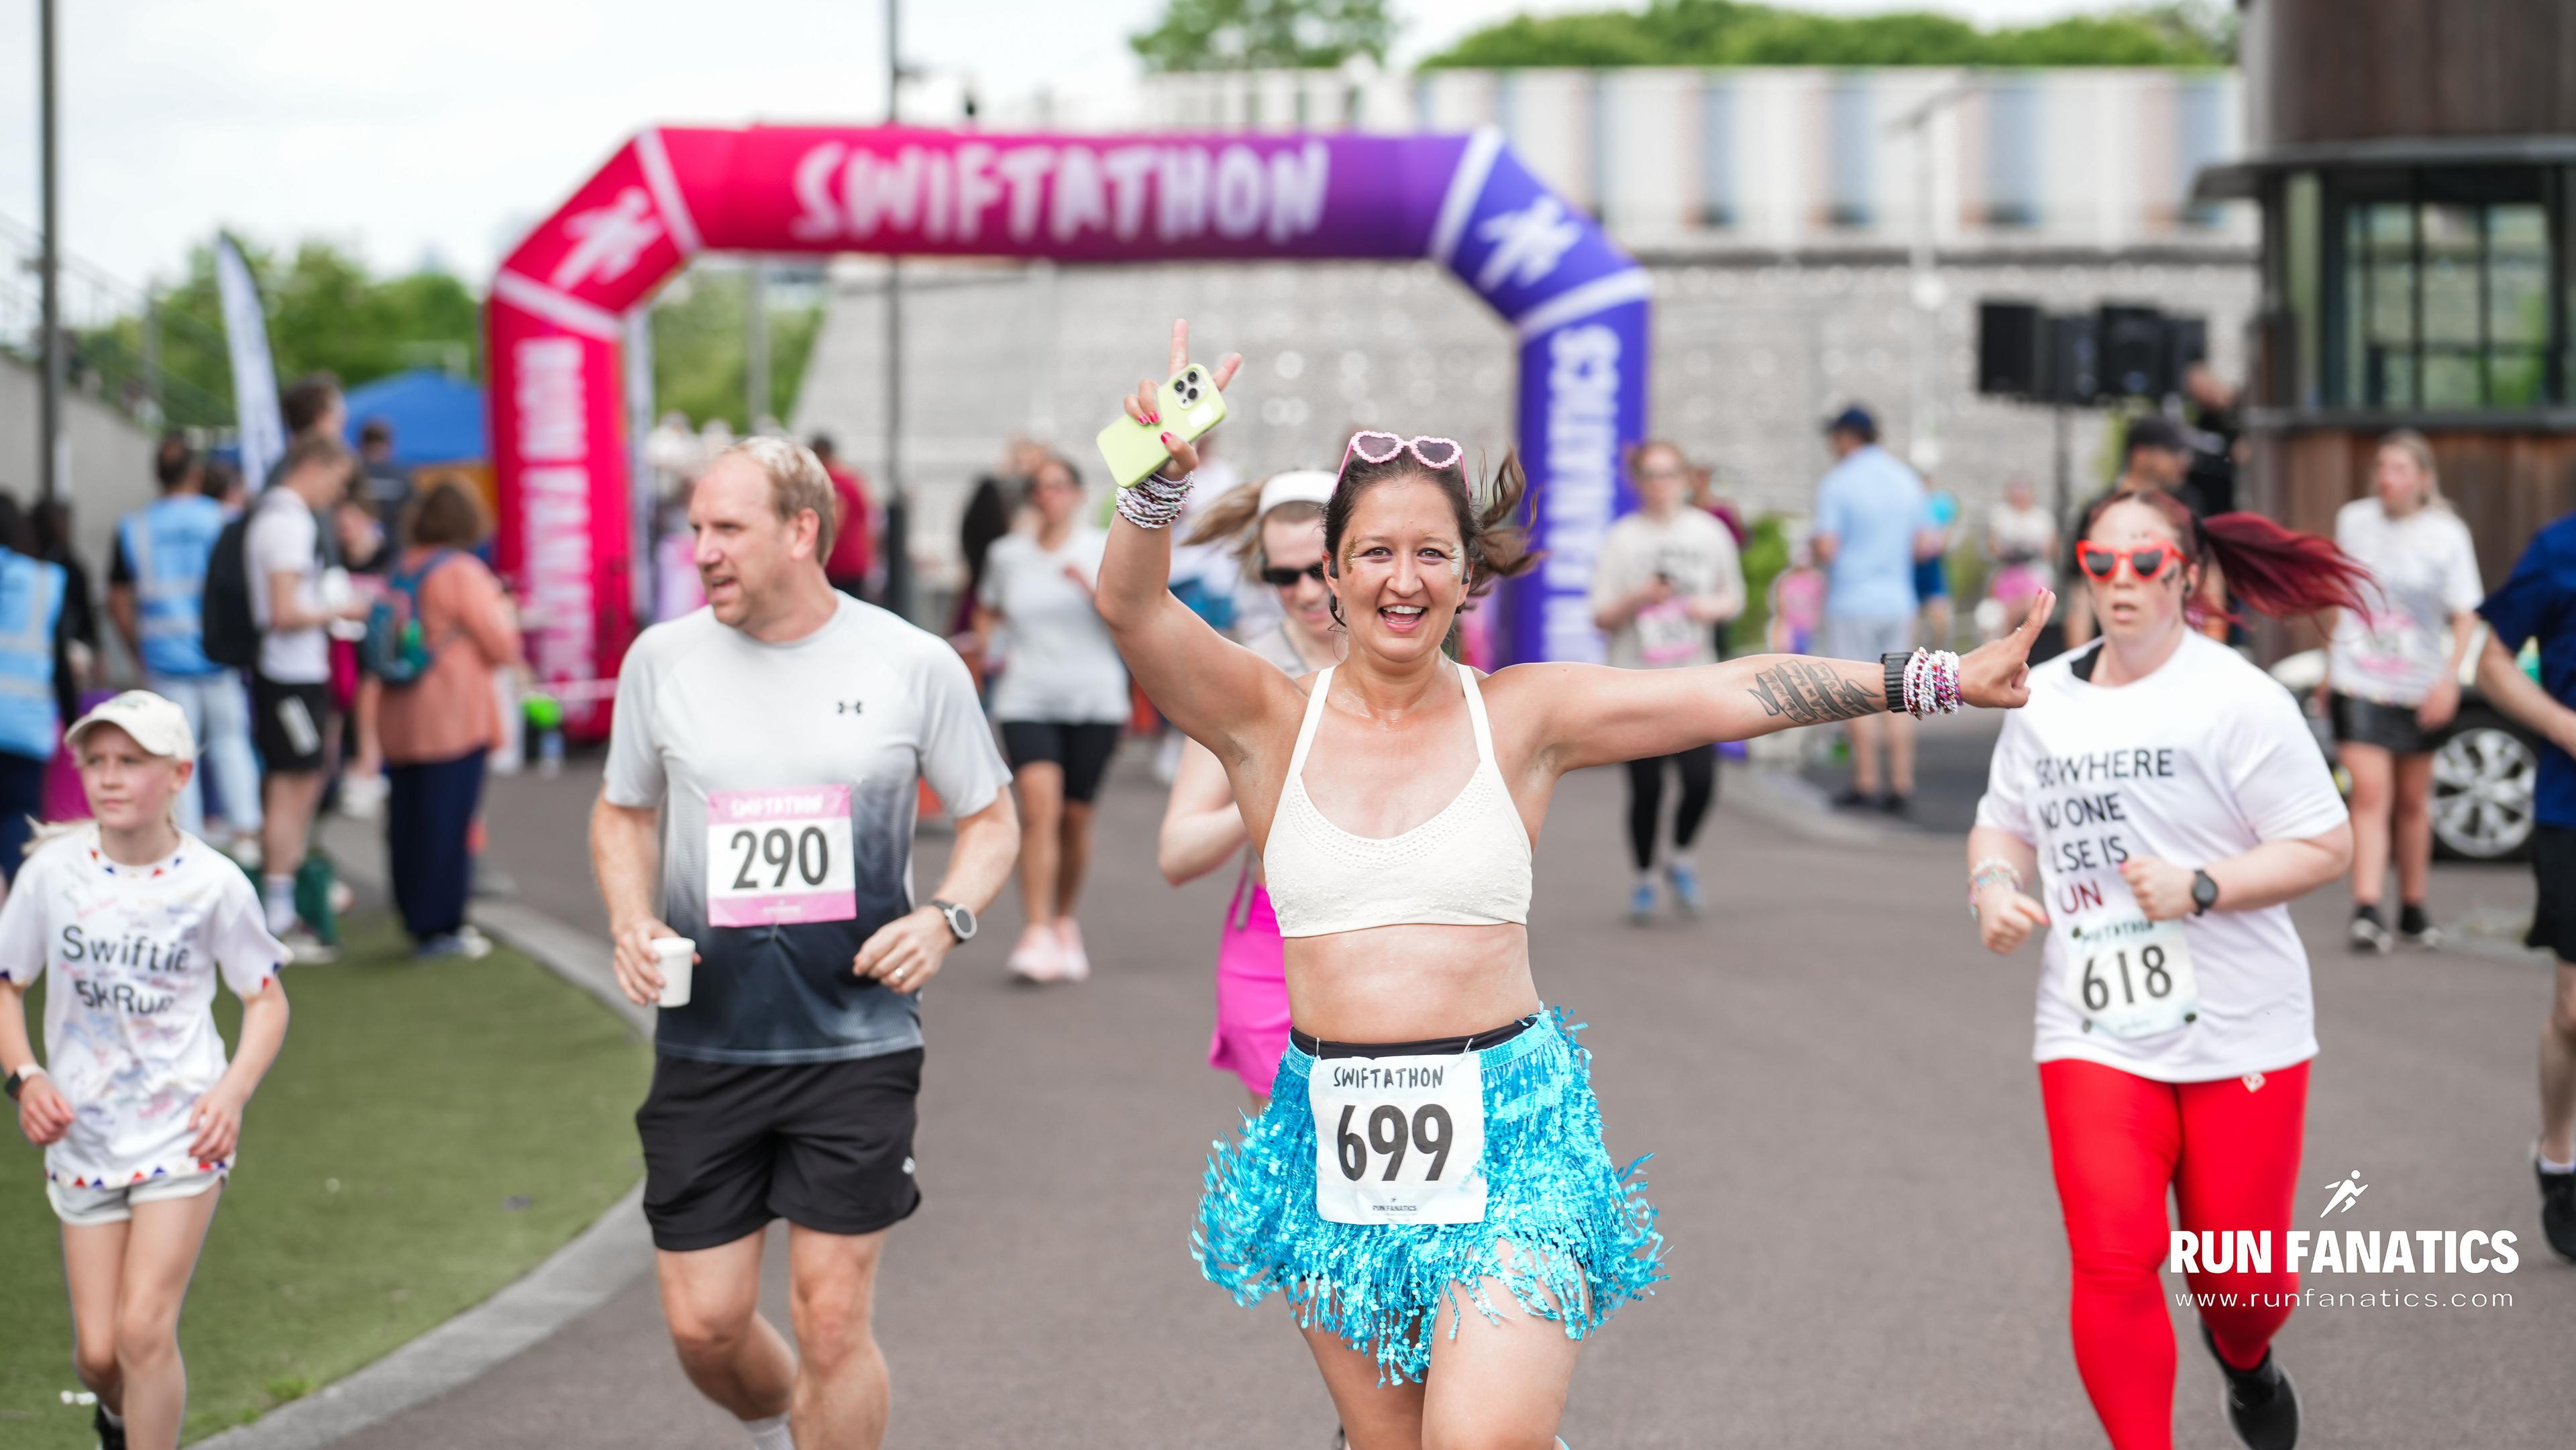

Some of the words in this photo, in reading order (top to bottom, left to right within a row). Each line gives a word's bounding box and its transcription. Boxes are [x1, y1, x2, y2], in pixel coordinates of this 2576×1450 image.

[788, 139, 1332, 243] SWIFTATHON
[2064, 792, 2126, 827] ONE
[731, 826, 828, 890] 290
[2100, 836, 2129, 865] IS
[62, 925, 191, 972] Swiftie
[2082, 944, 2173, 1012] 618
[1334, 1065, 1444, 1088] SWIFTATHON
[1337, 1103, 1453, 1182] 699
